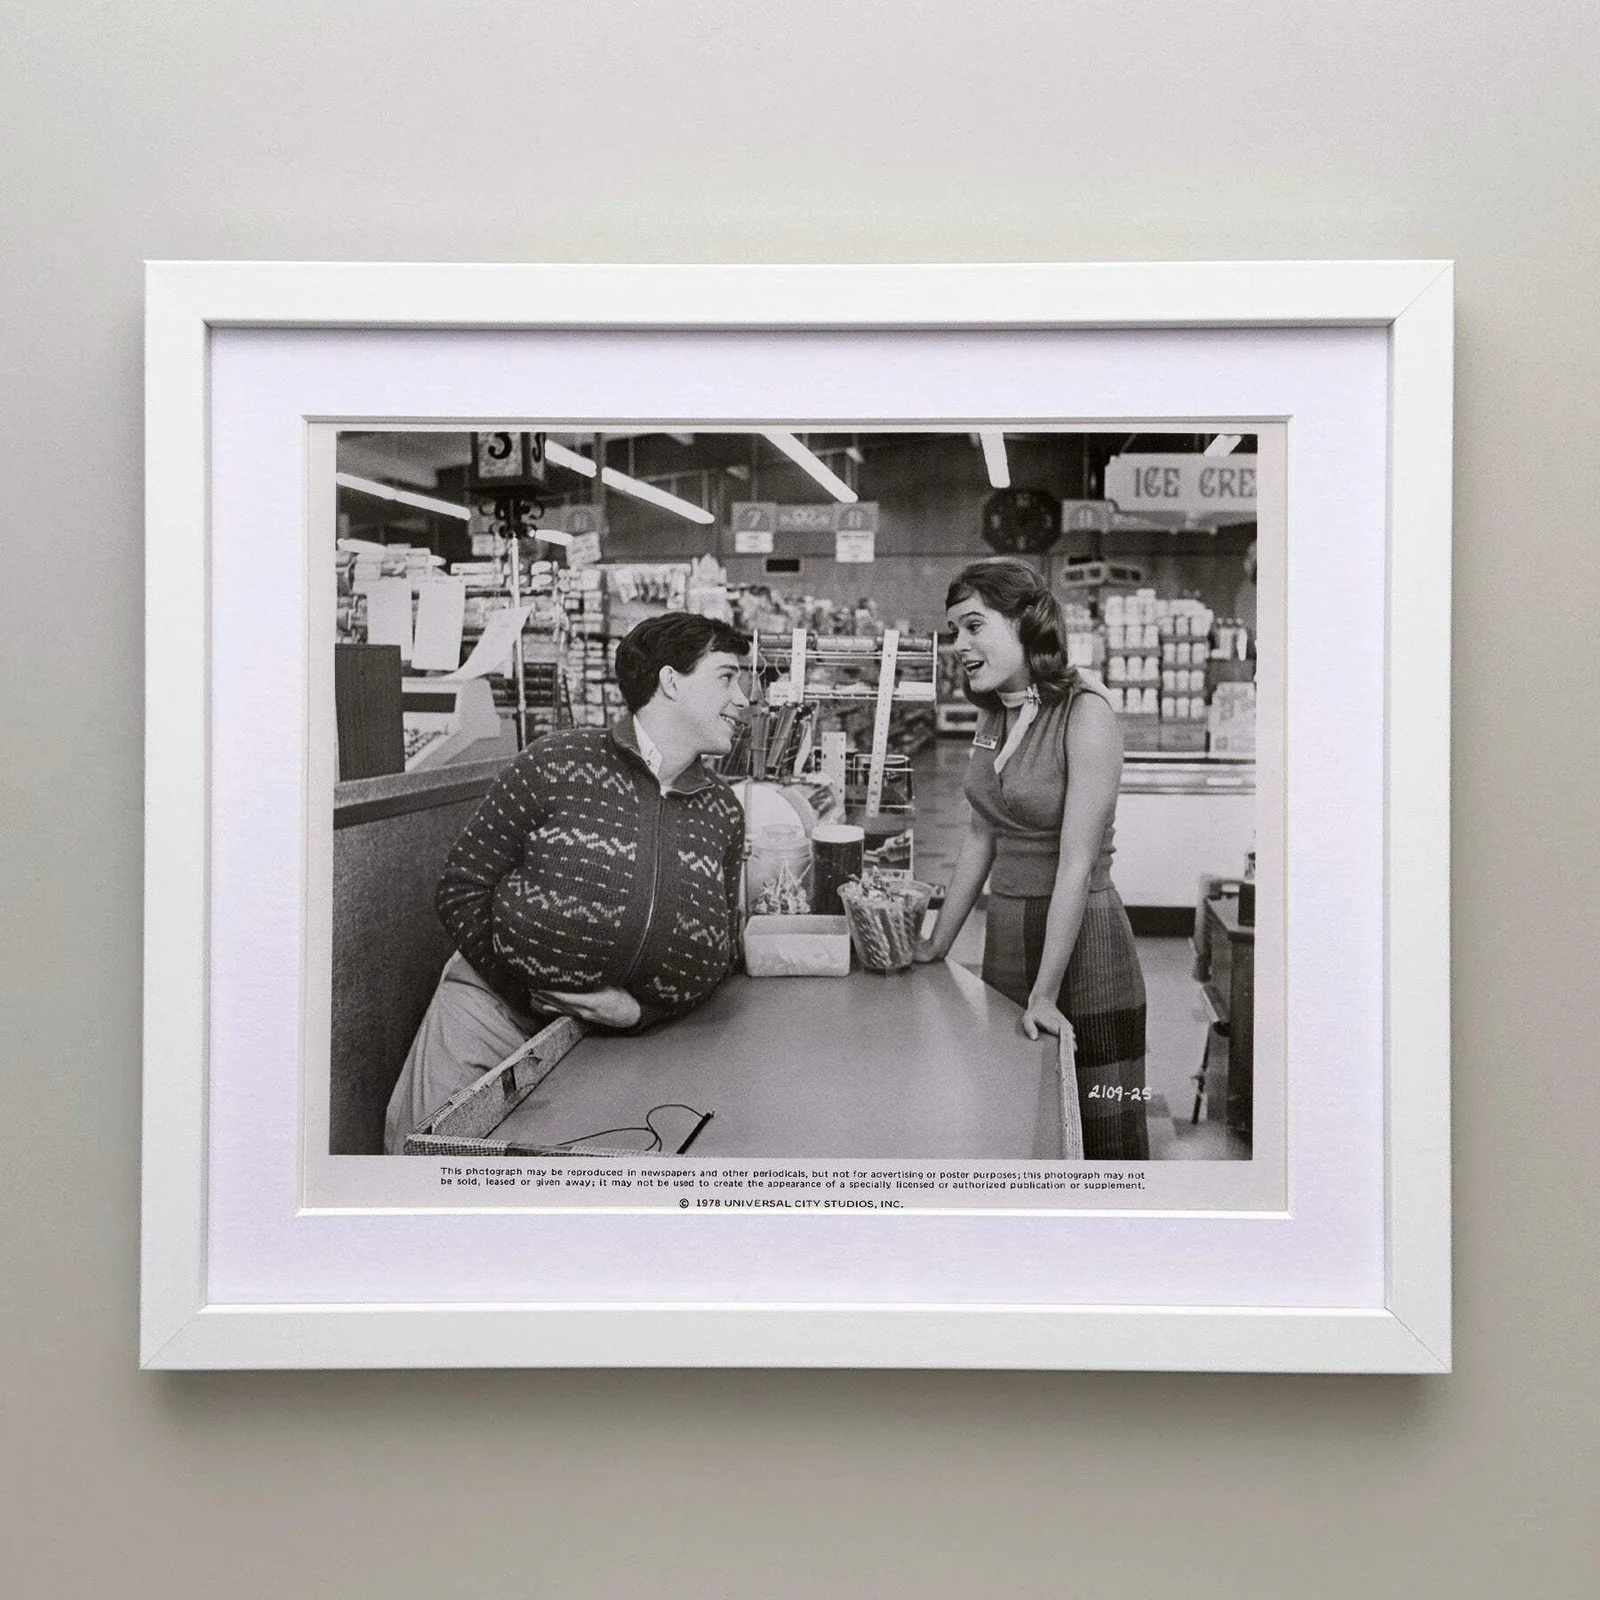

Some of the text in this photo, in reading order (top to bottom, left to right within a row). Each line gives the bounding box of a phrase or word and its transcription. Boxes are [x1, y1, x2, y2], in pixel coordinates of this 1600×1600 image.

[1135, 467, 1180, 497] ICE
[1088, 1084, 1152, 1102] 2109-25
[440, 1167, 1145, 1181] This photograph may be reproduced in newspapers and other periodicals, but not for advertising or poster purposes; this photograph may not
[441, 1177, 452, 1186] be
[457, 1177, 480, 1188] sold,
[486, 1178, 515, 1186] leased
[535, 1178, 560, 1188] given
[566, 1180, 595, 1189] away;
[599, 1178, 607, 1187] it
[612, 1180, 632, 1189] may
[637, 1179, 654, 1187] not
[658, 1179, 669, 1187] be
[674, 1179, 696, 1187] used
[699, 1179, 711, 1188] to
[714, 1179, 743, 1188] create
[747, 1179, 764, 1188] the
[768, 1181, 821, 1190] appearance
[825, 1180, 836, 1188] of
[849, 1180, 891, 1190] specially
[896, 1180, 934, 1189] licensed
[953, 1180, 1006, 1189] authorized
[1010, 1181, 1065, 1191] publication
[1084, 1181, 1145, 1192] supplement.
[696, 1198, 721, 1208] 1978
[724, 1199, 793, 1208] UNIVERSAL
[795, 1199, 821, 1209] CITY
[824, 1199, 877, 1210] STUDIOS,
[881, 1200, 904, 1209] INC.
